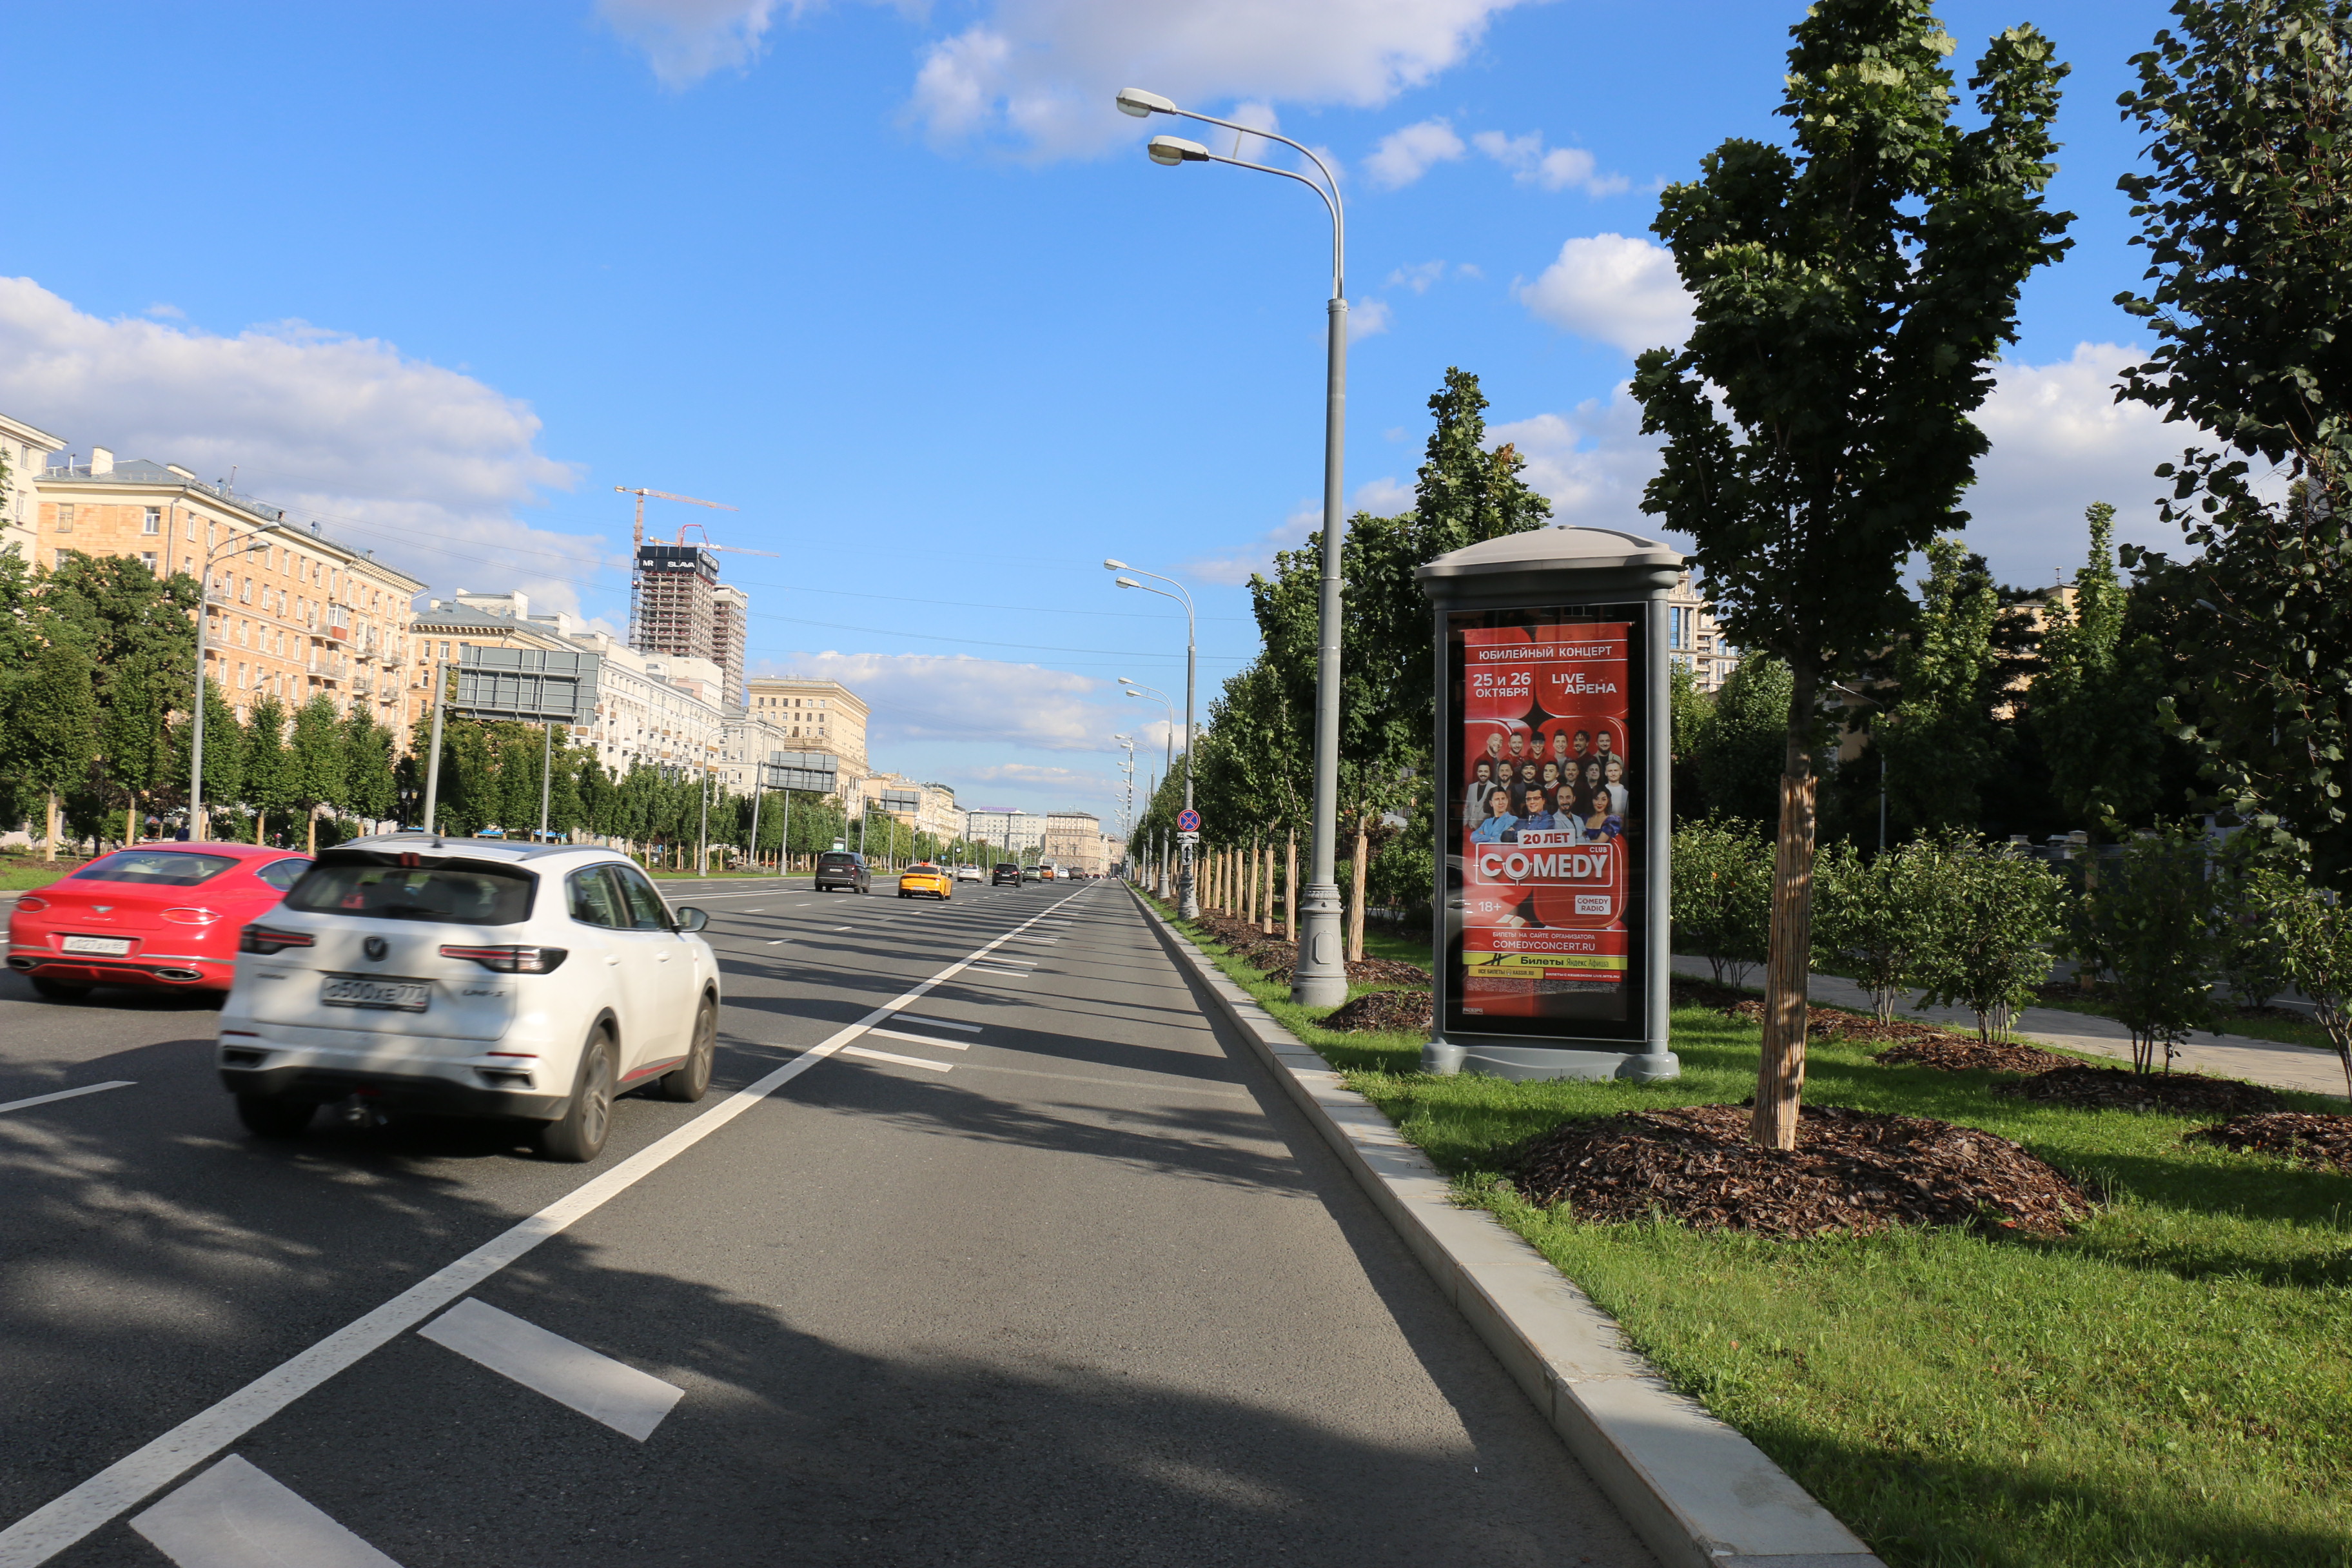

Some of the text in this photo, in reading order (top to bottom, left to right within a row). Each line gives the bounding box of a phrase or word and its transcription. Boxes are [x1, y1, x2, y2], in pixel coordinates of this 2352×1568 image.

[1479, 645, 1612, 660] ЮБИЛЕЙНЫЙ КОНЦЕРТ
[1473, 673, 1493, 687] 25
[1511, 672, 1531, 685] 26
[1552, 672, 1585, 684] LIVE
[1476, 687, 1529, 698] ОКТЯБРЯ
[1564, 682, 1617, 694] АРЕНА
[1523, 832, 1570, 845] 20 ЛЕТ
[1480, 853, 1608, 878] COMEDY
[1478, 901, 1502, 912] 18+
[1493, 940, 1596, 951] COMEDYCONCERT.RU
[1520, 957, 1609, 968] Билеты Яндекс Афиша
